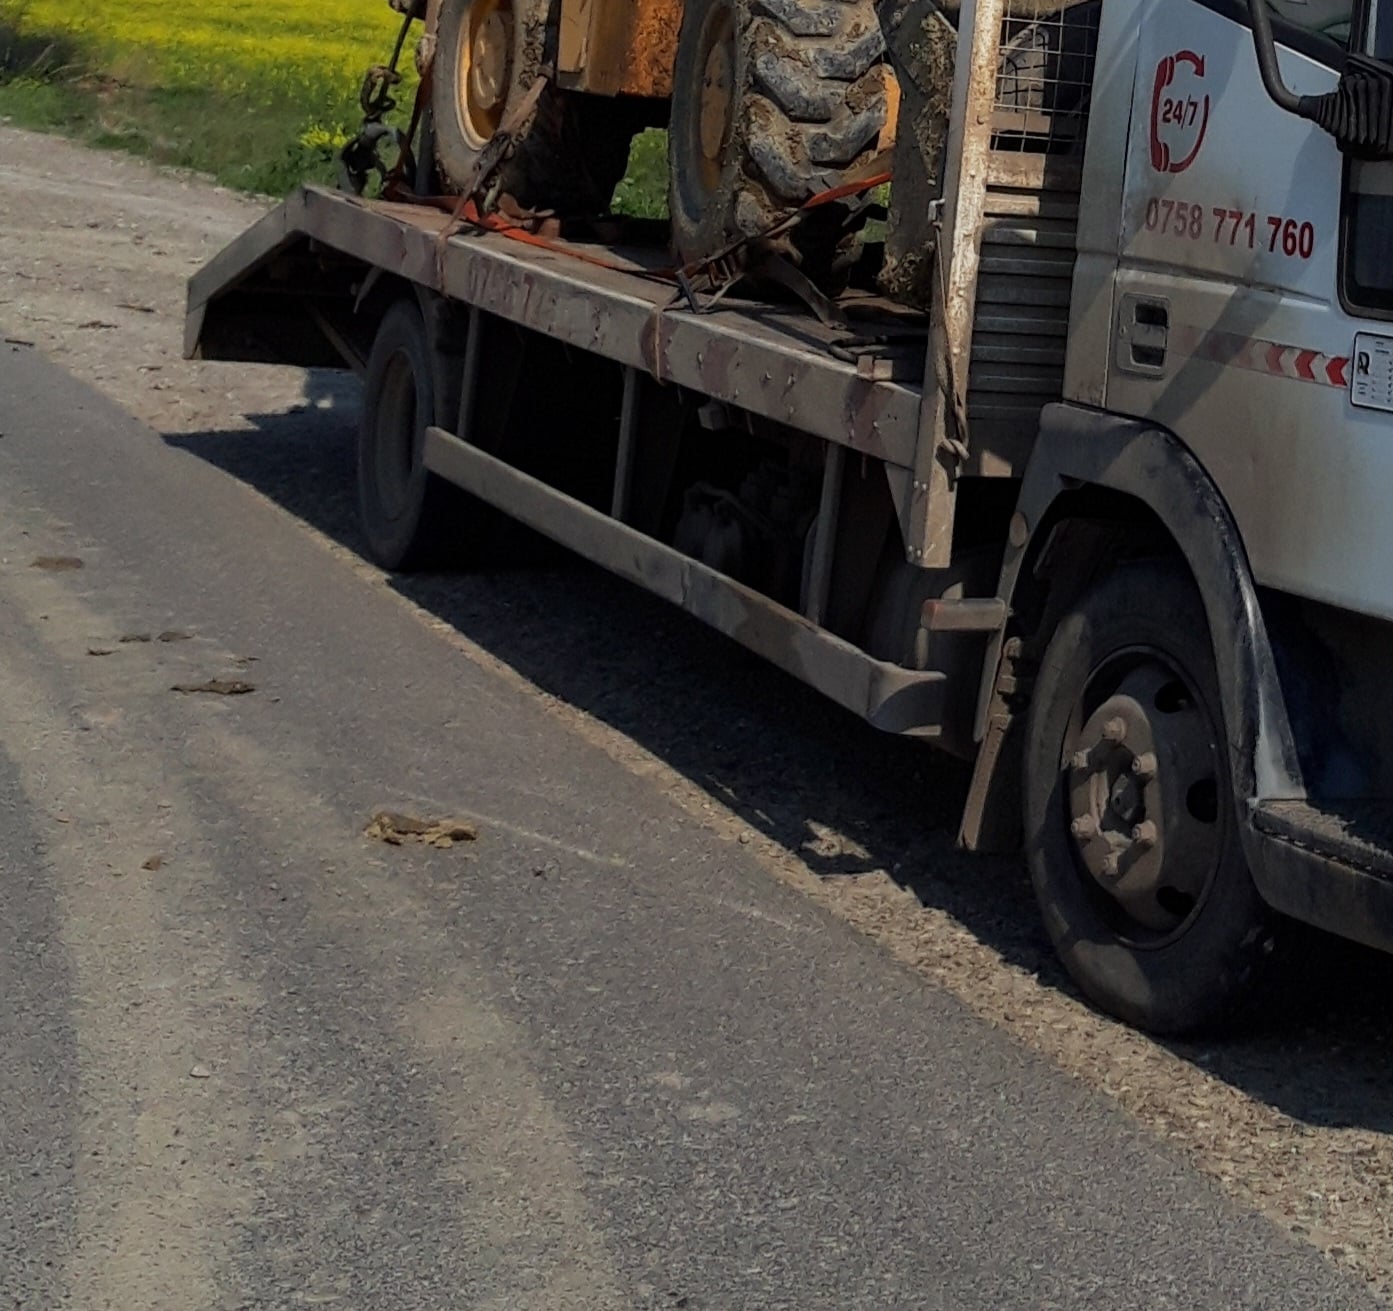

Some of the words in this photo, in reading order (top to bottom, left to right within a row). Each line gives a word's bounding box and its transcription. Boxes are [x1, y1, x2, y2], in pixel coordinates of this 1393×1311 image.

[1162, 94, 1198, 130] 24/7
[1145, 197, 1203, 240] 0758
[1212, 207, 1256, 249] 771
[1267, 216, 1314, 259] 760
